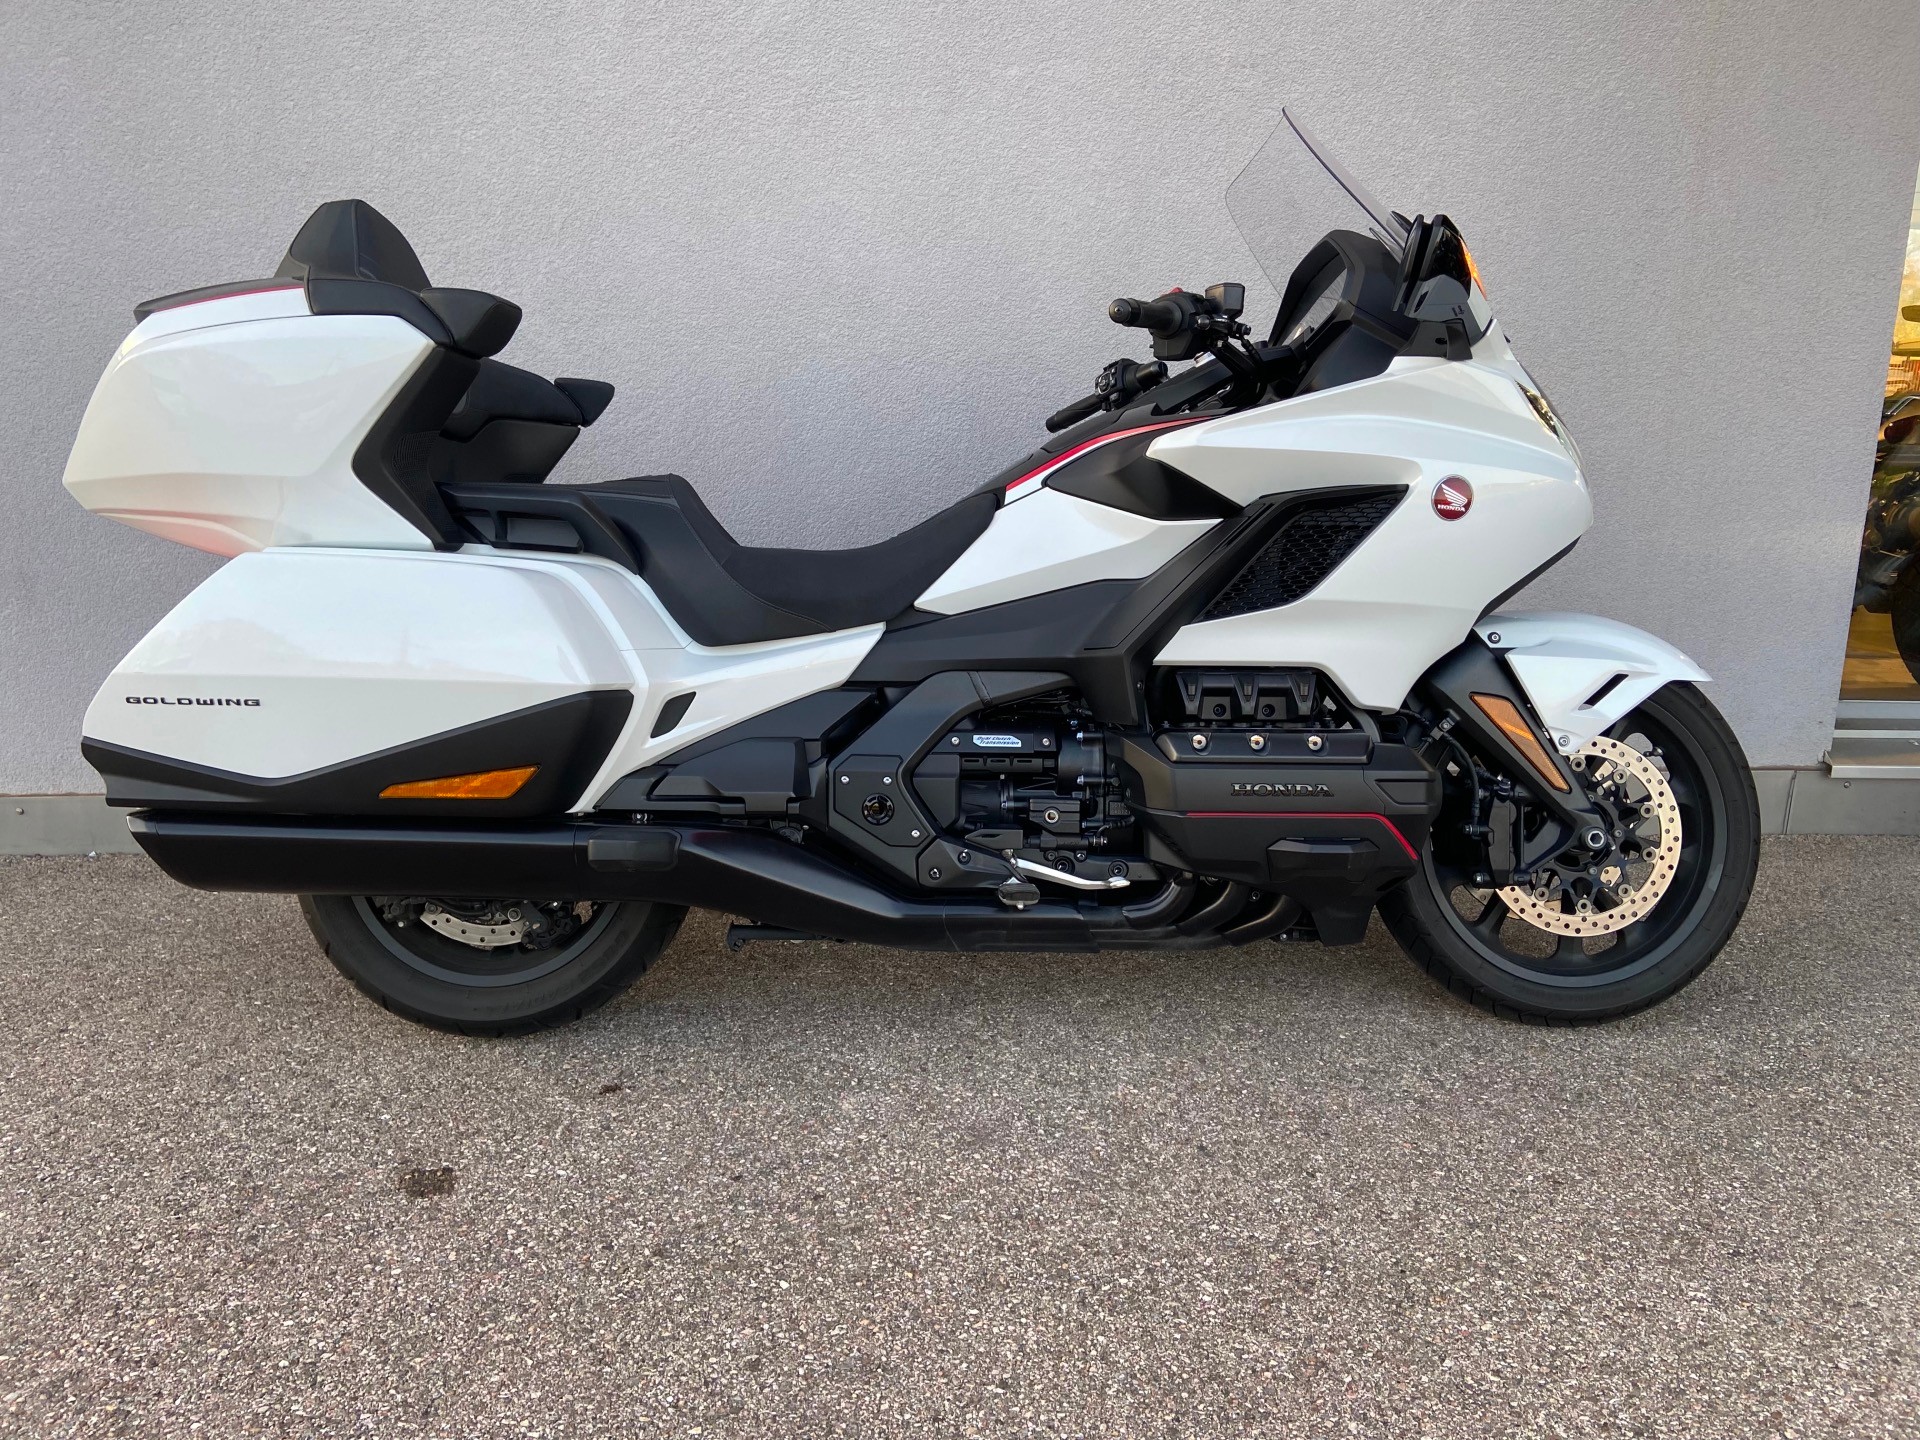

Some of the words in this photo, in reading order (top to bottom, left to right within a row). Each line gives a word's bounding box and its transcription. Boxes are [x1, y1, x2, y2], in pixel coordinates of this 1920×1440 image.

[1437, 504, 1466, 512] HONDA
[125, 696, 261, 706] GOLDWING
[1231, 783, 1335, 797] HONDA
